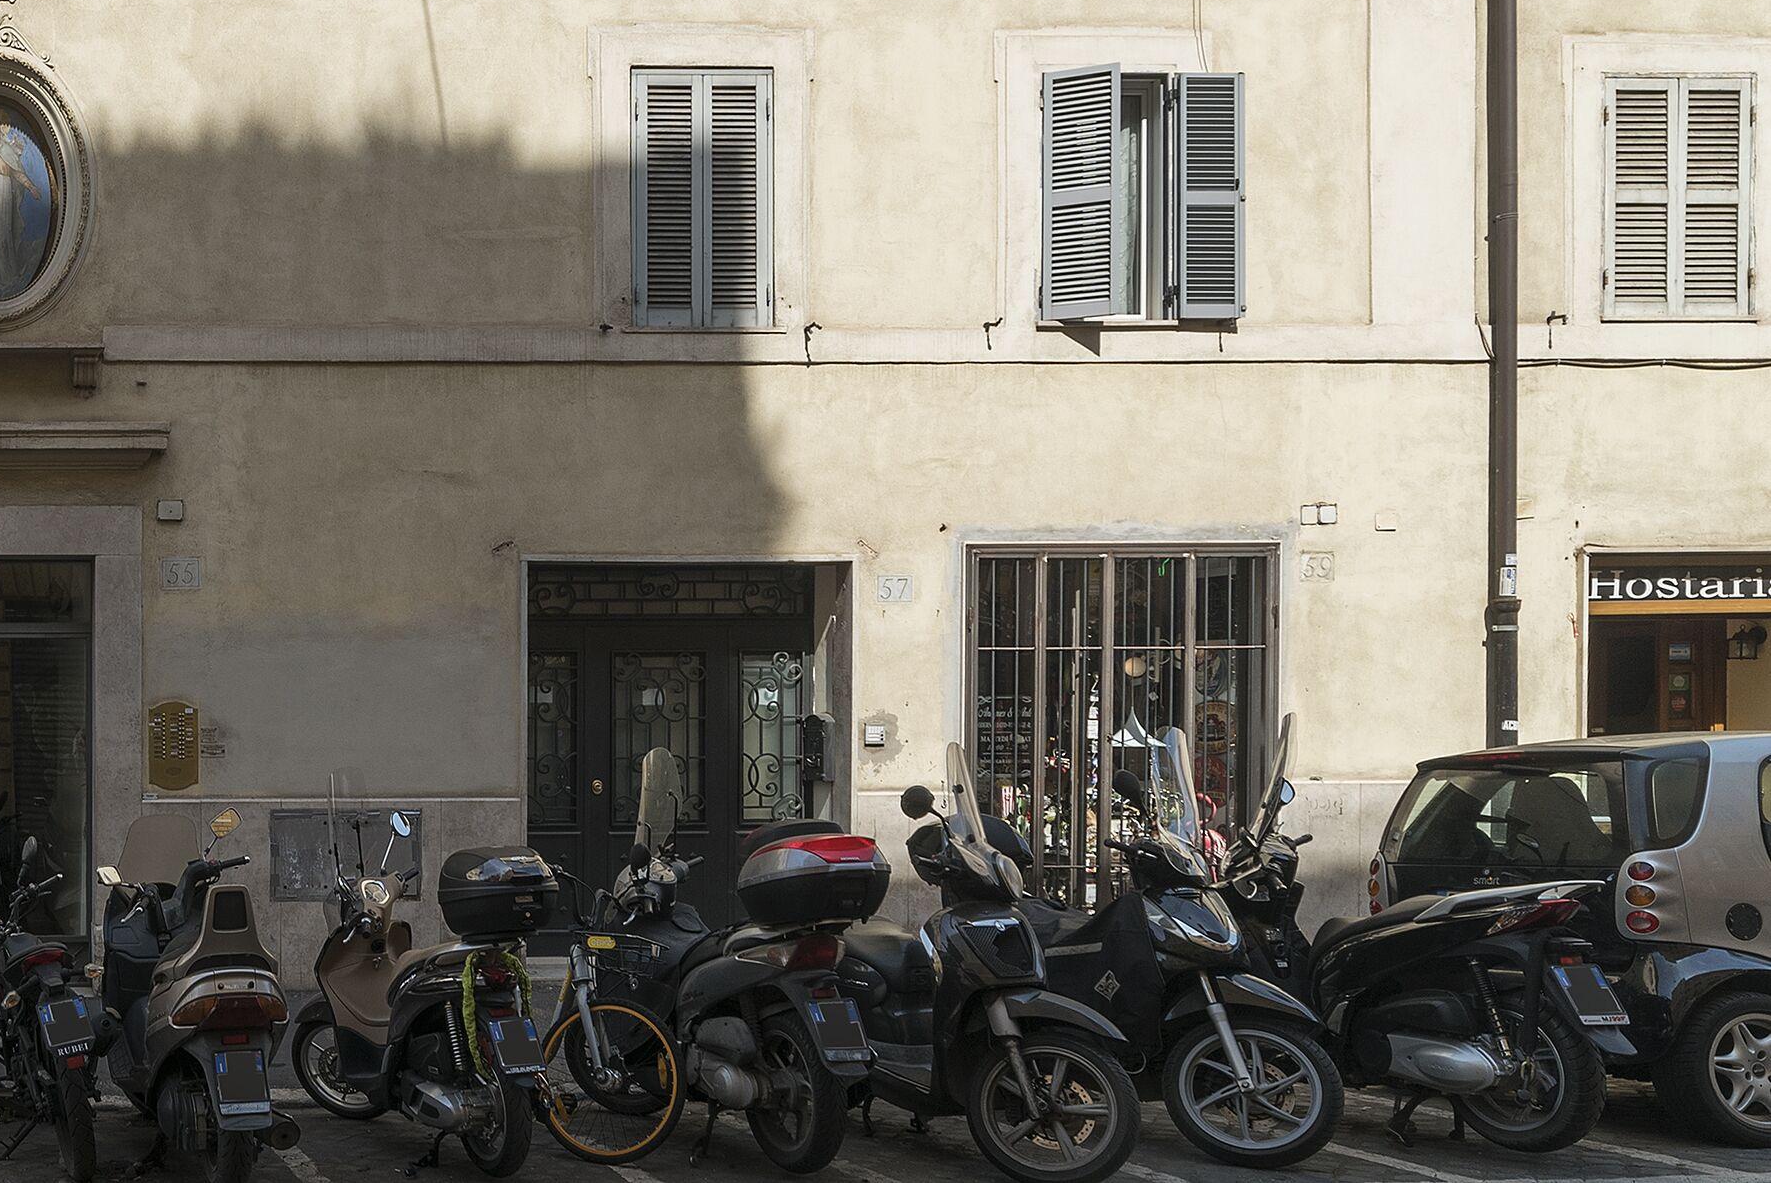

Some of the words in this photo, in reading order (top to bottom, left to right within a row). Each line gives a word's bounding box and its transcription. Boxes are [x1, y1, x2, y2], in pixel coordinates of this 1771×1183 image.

[166, 562, 196, 585] 55
[1302, 556, 1332, 578] 59
[879, 578, 908, 600] 57
[1589, 568, 1771, 599] Hostari
[1473, 876, 1500, 886] smart
